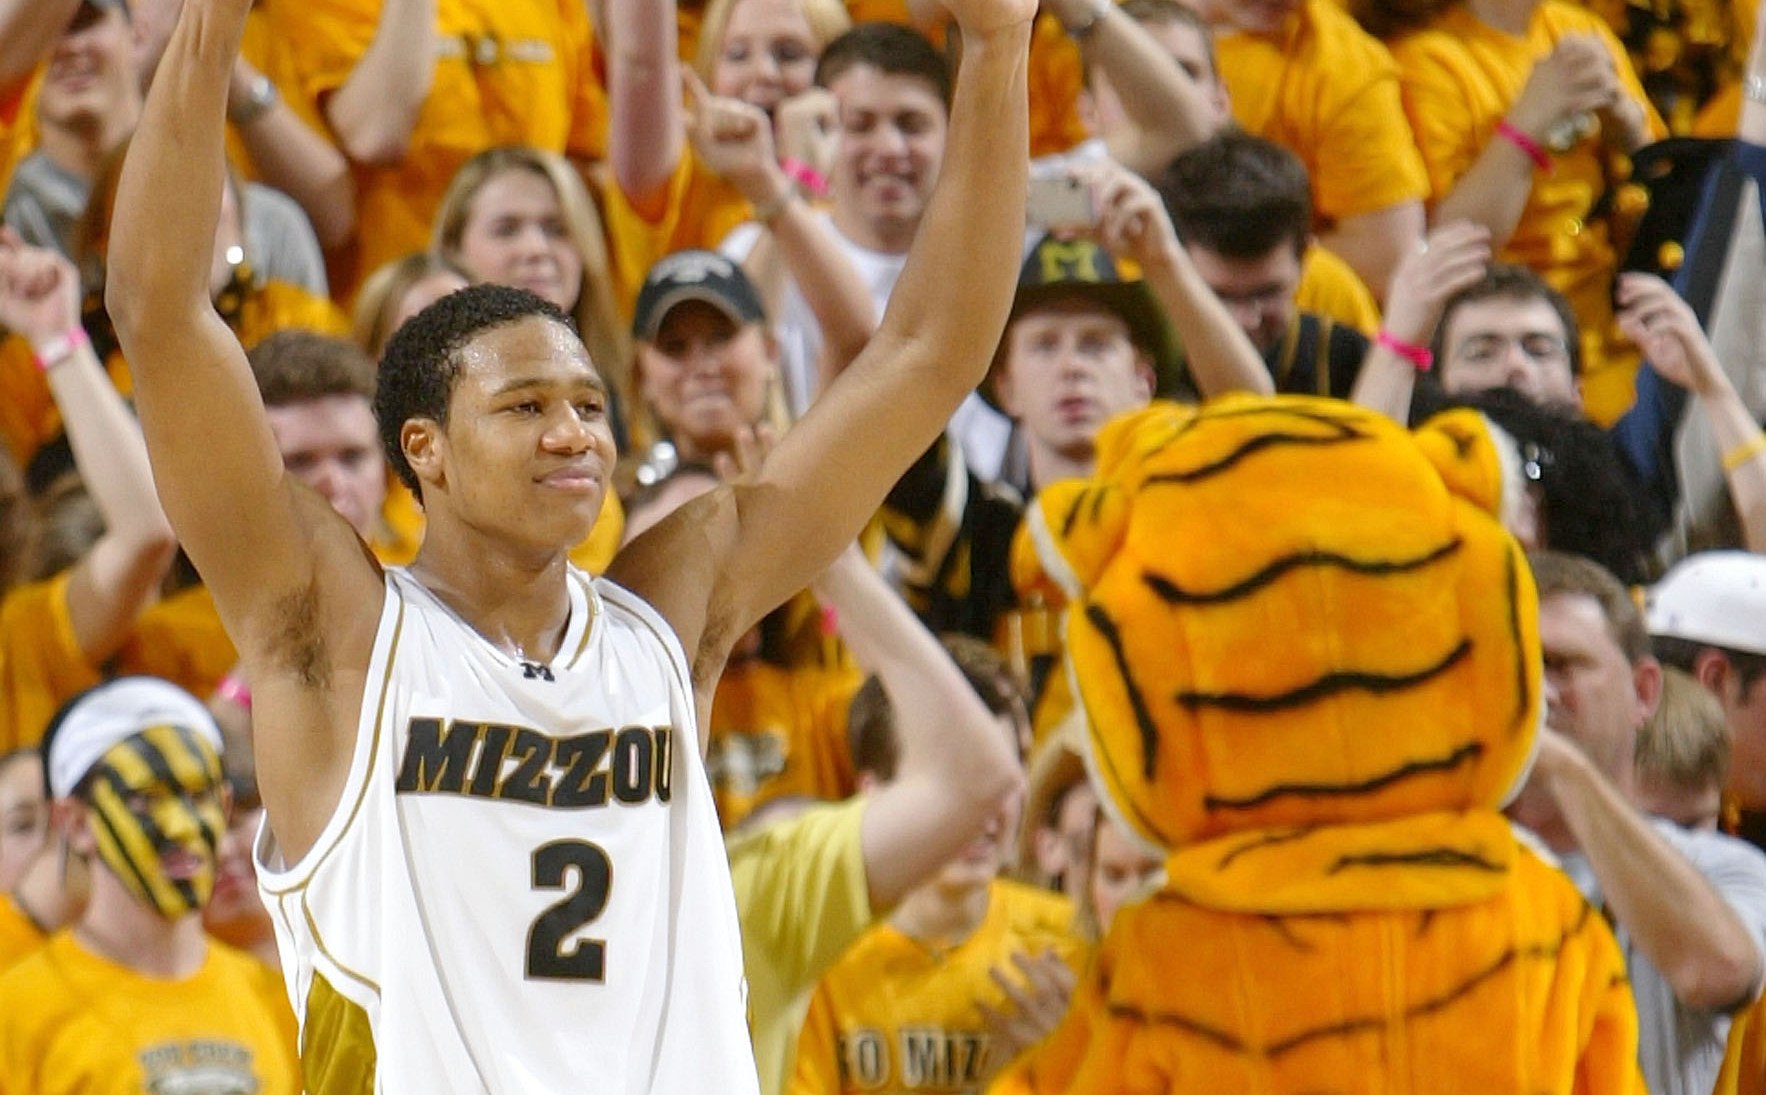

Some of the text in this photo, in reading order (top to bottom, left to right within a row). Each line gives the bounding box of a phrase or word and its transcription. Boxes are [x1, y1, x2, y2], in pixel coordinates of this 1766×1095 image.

[1041, 241, 1099, 284] M
[519, 662, 555, 682] M
[396, 715, 672, 808] MIZZOU
[524, 838, 613, 985] 2
